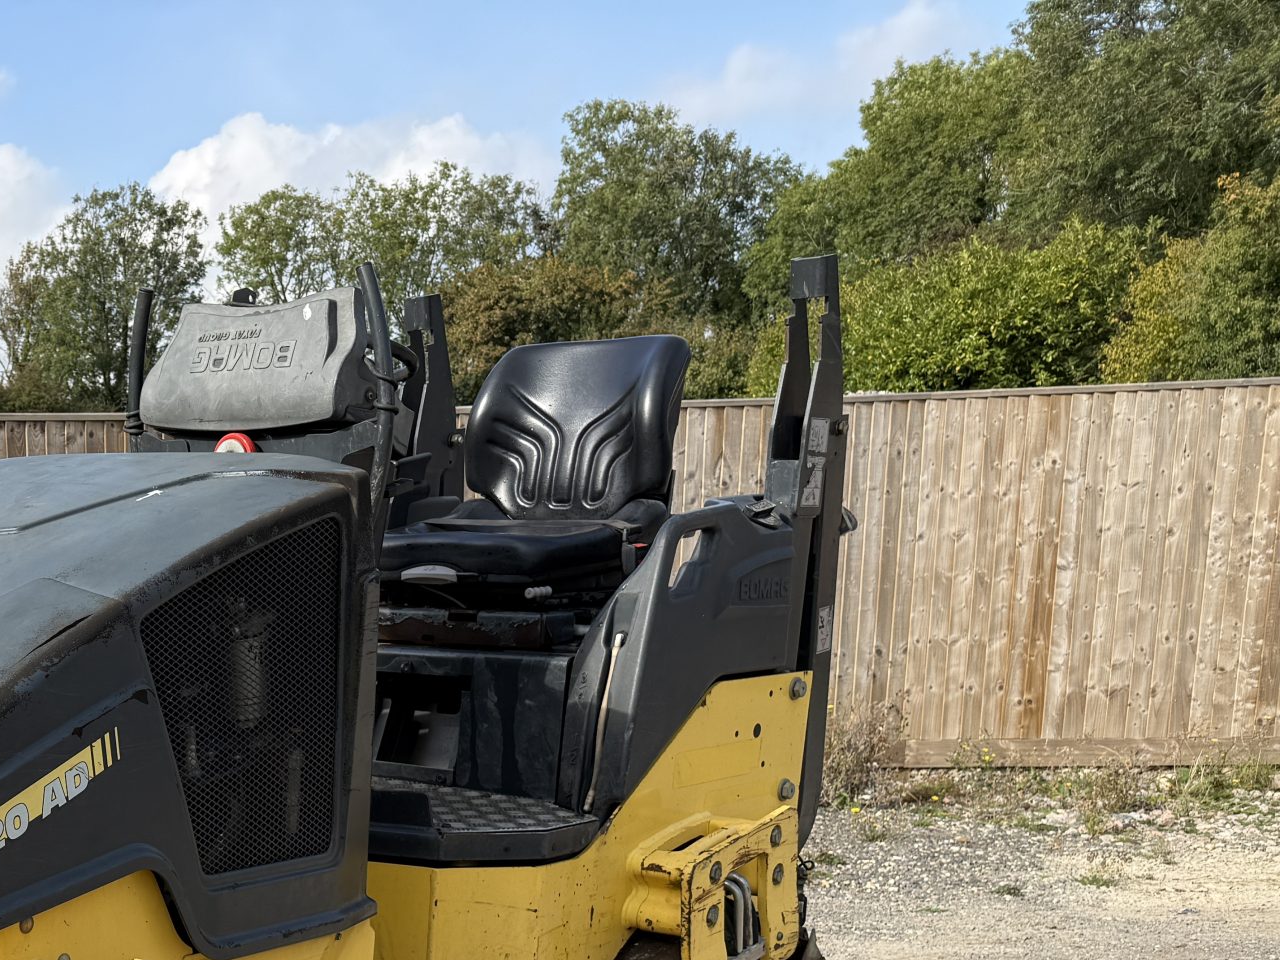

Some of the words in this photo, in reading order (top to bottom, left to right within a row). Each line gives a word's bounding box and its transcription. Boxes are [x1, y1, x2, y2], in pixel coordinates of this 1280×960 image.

[198, 332, 231, 343] GROUP
[231, 328, 262, 340] FAYAT
[190, 339, 297, 373] BOMAG
[42, 761, 90, 820] AD
